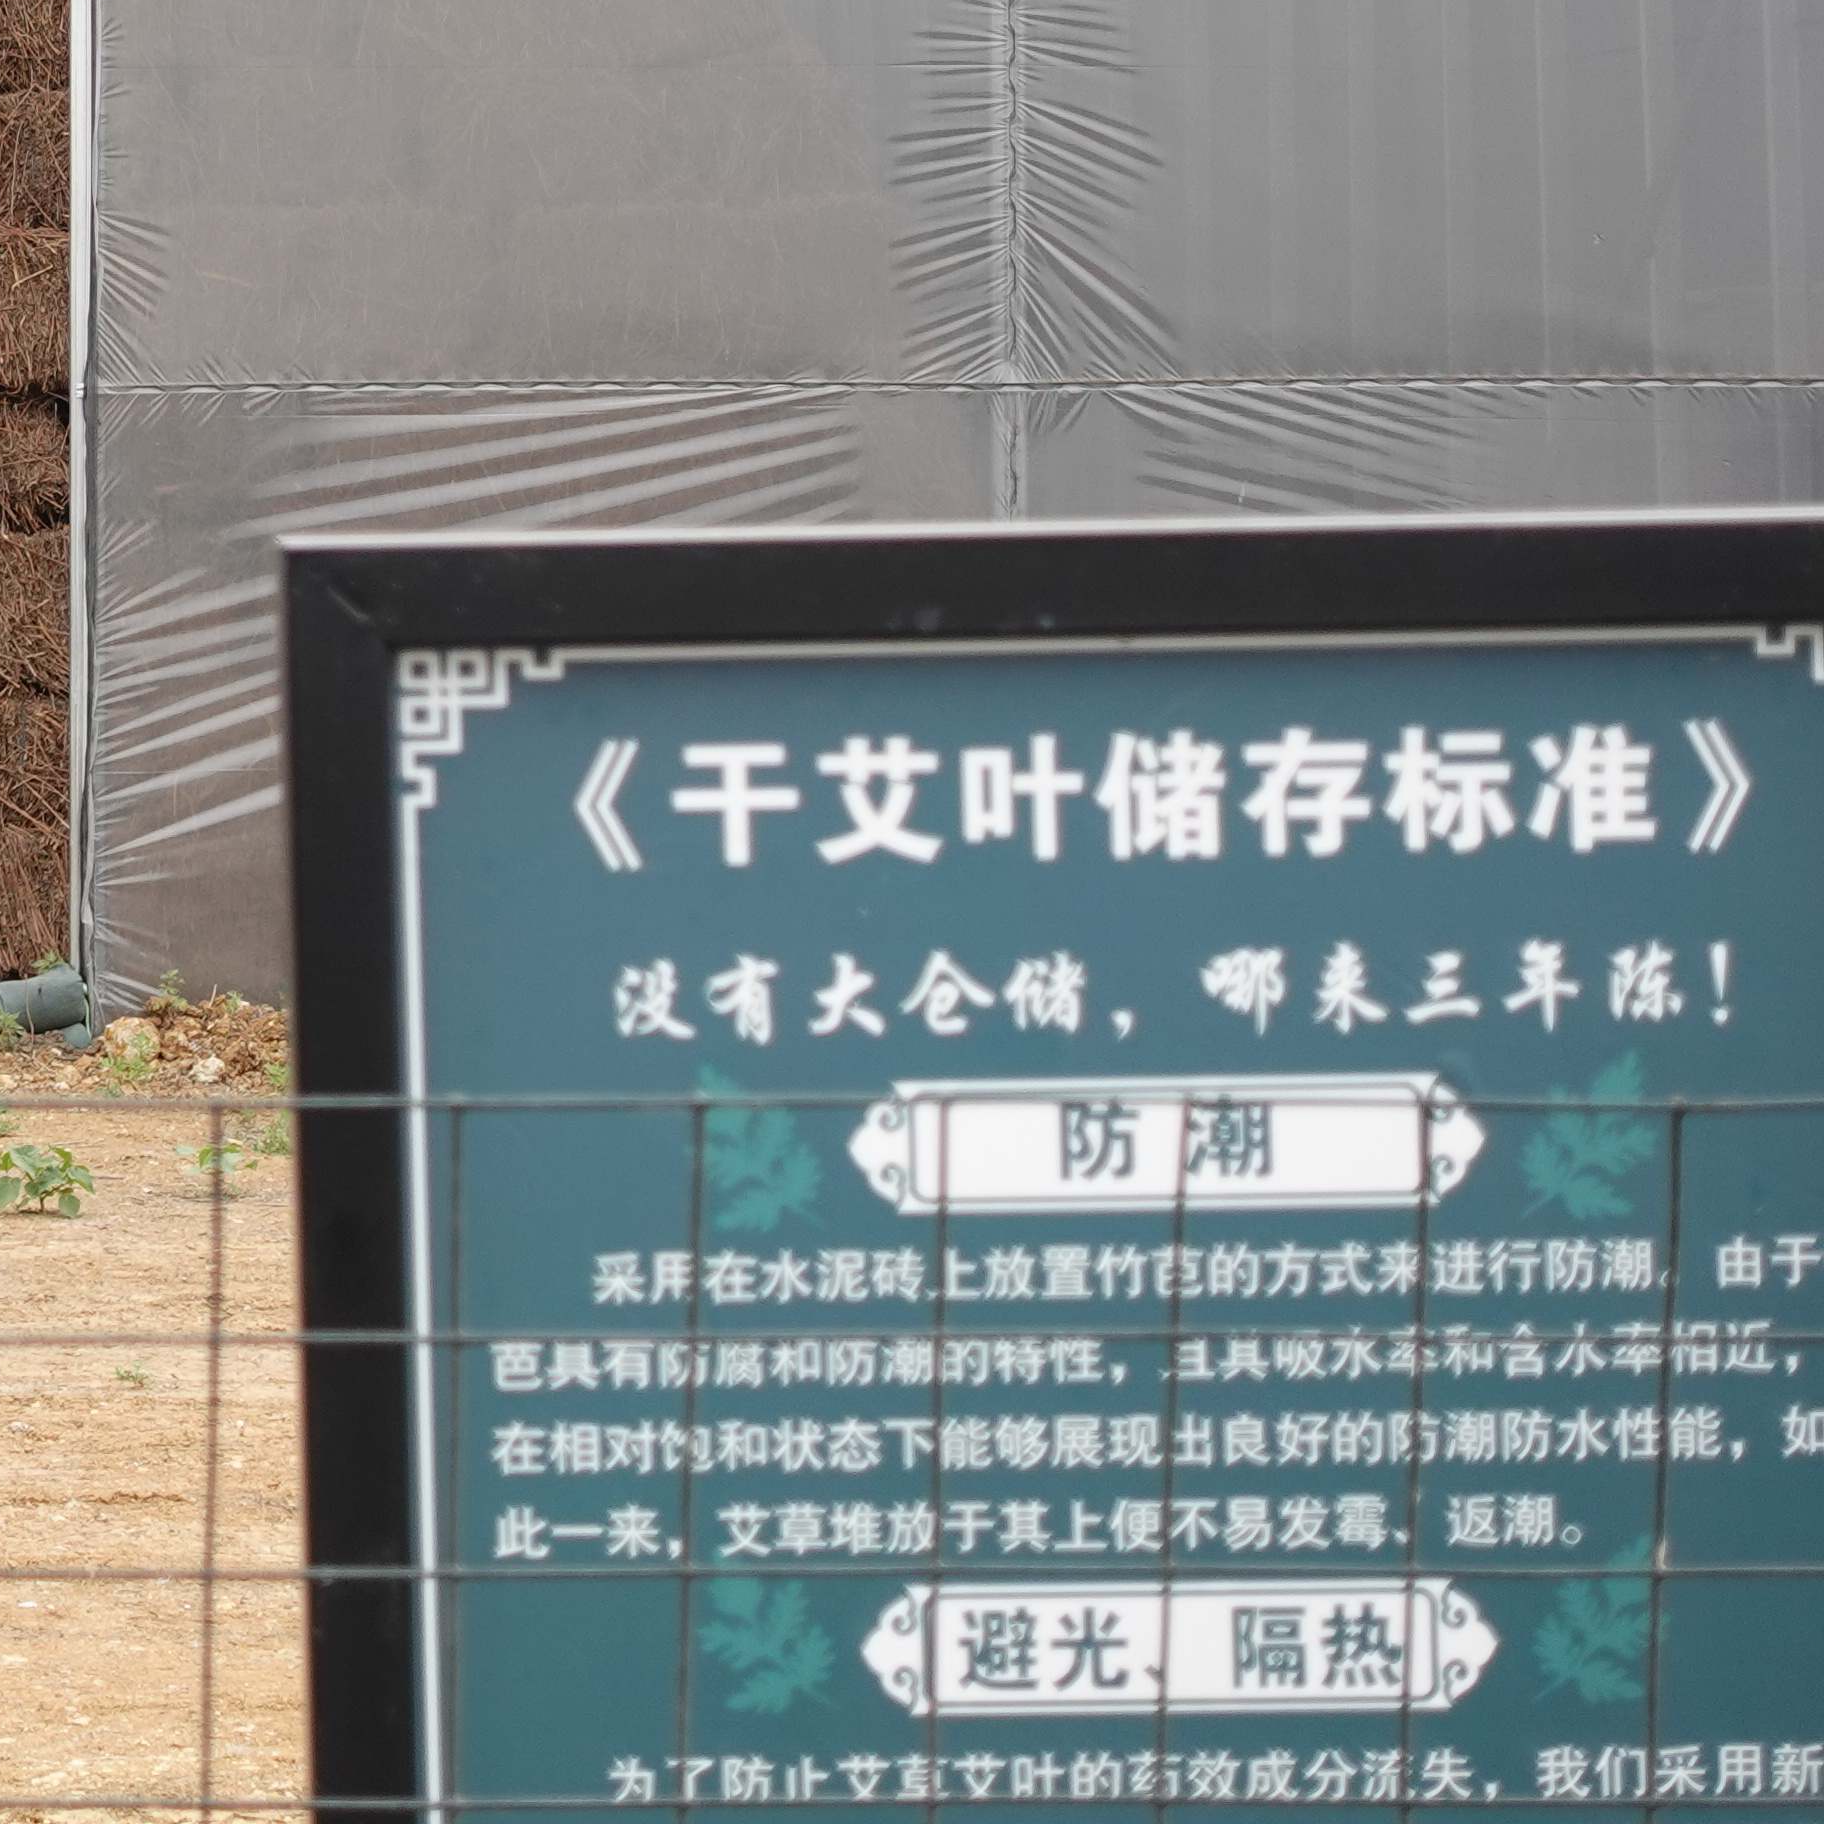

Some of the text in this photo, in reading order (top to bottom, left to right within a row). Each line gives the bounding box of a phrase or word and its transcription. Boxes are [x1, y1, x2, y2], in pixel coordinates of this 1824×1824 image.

[574, 719, 1751, 872] 《干艾叶储存标准》
[1059, 1092, 1274, 1180] 防潮
[957, 1600, 1408, 1693] 避光、隔热
